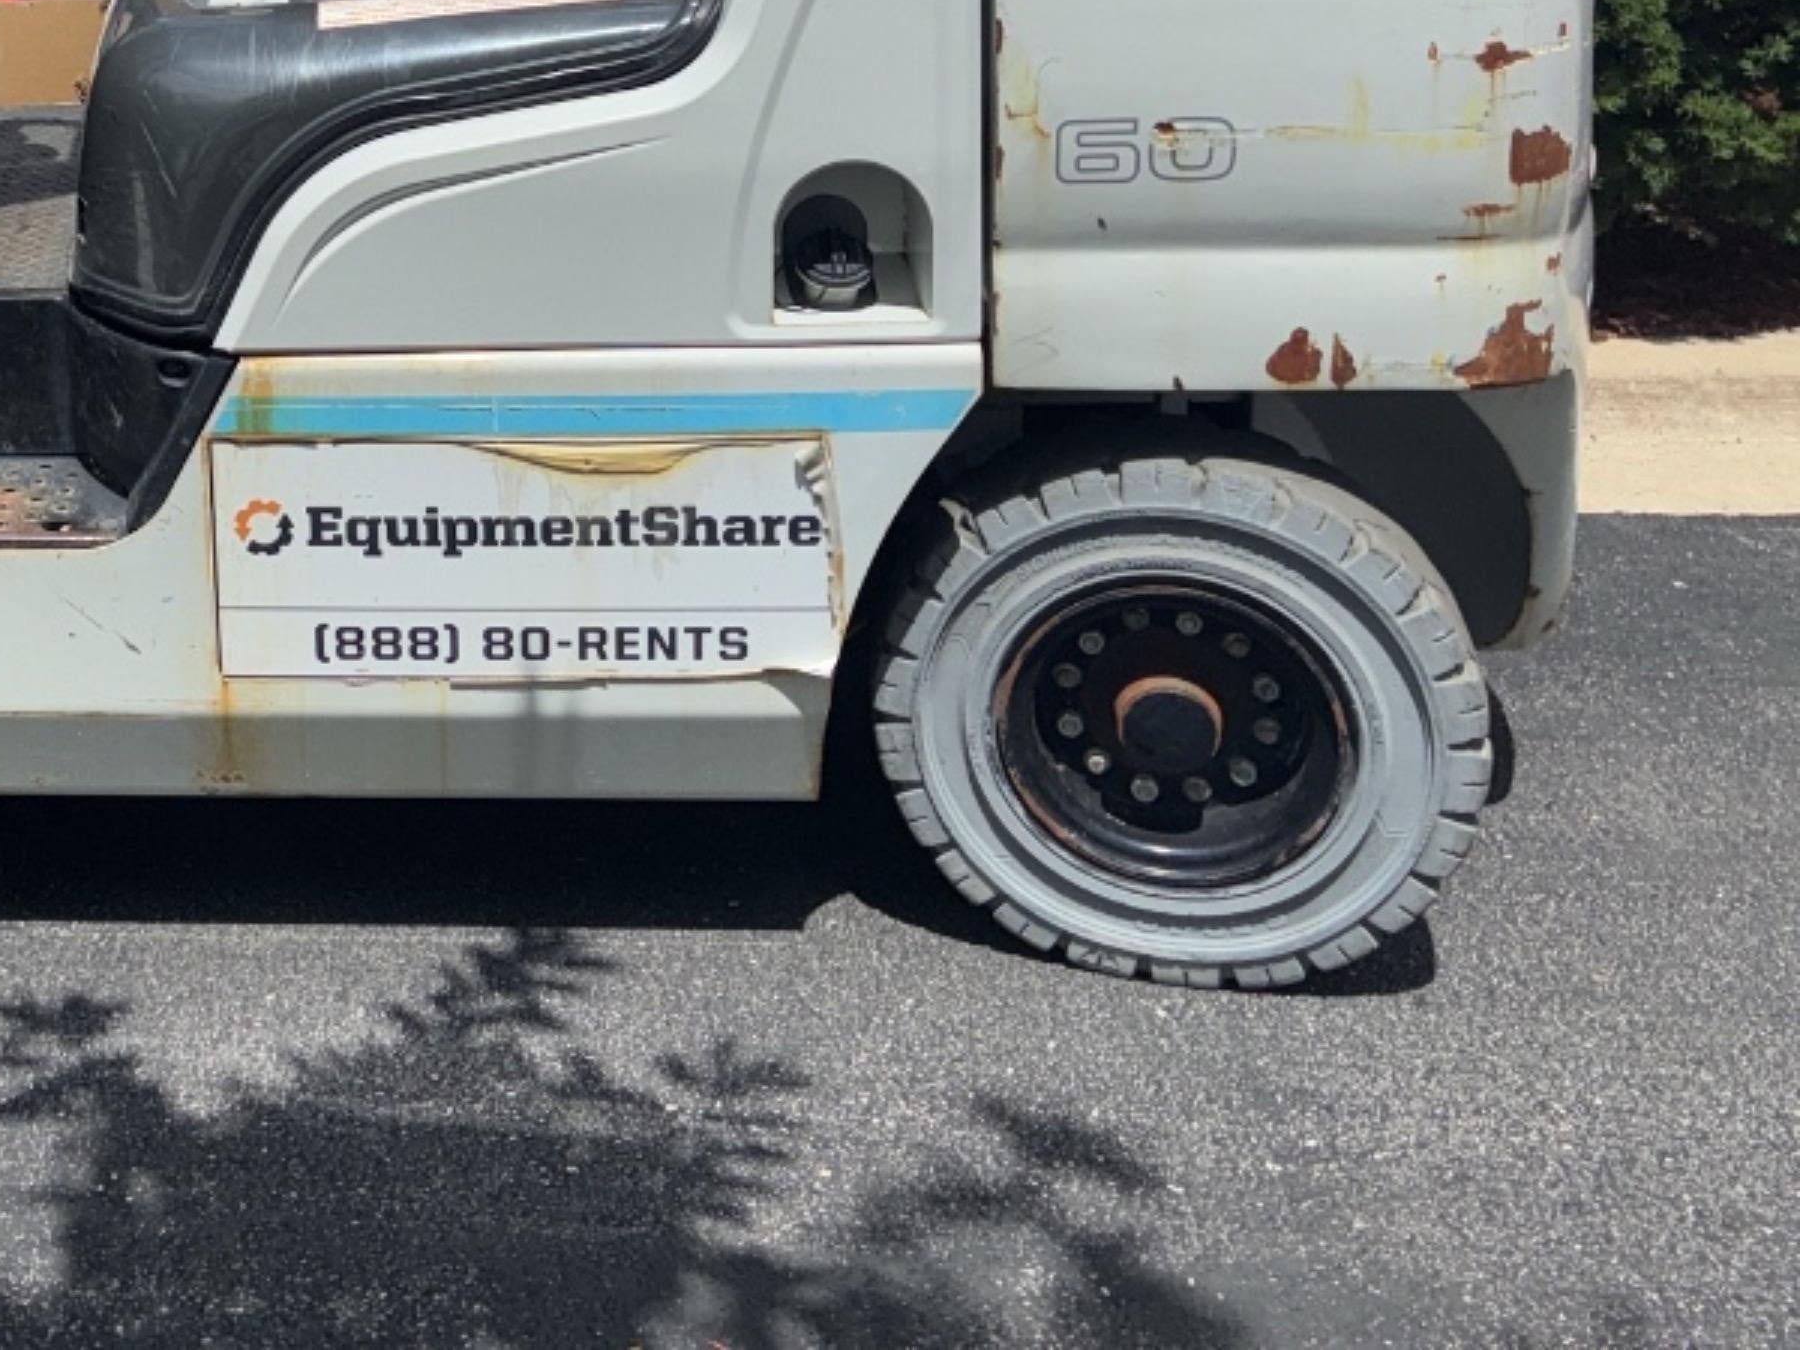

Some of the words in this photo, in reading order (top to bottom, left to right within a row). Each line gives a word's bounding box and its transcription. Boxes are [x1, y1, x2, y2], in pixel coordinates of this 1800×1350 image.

[1055, 116, 1237, 184] 60
[306, 505, 822, 558] EquipmentShare
[314, 623, 460, 665] (888)
[482, 626, 750, 662] 80-RENTS
